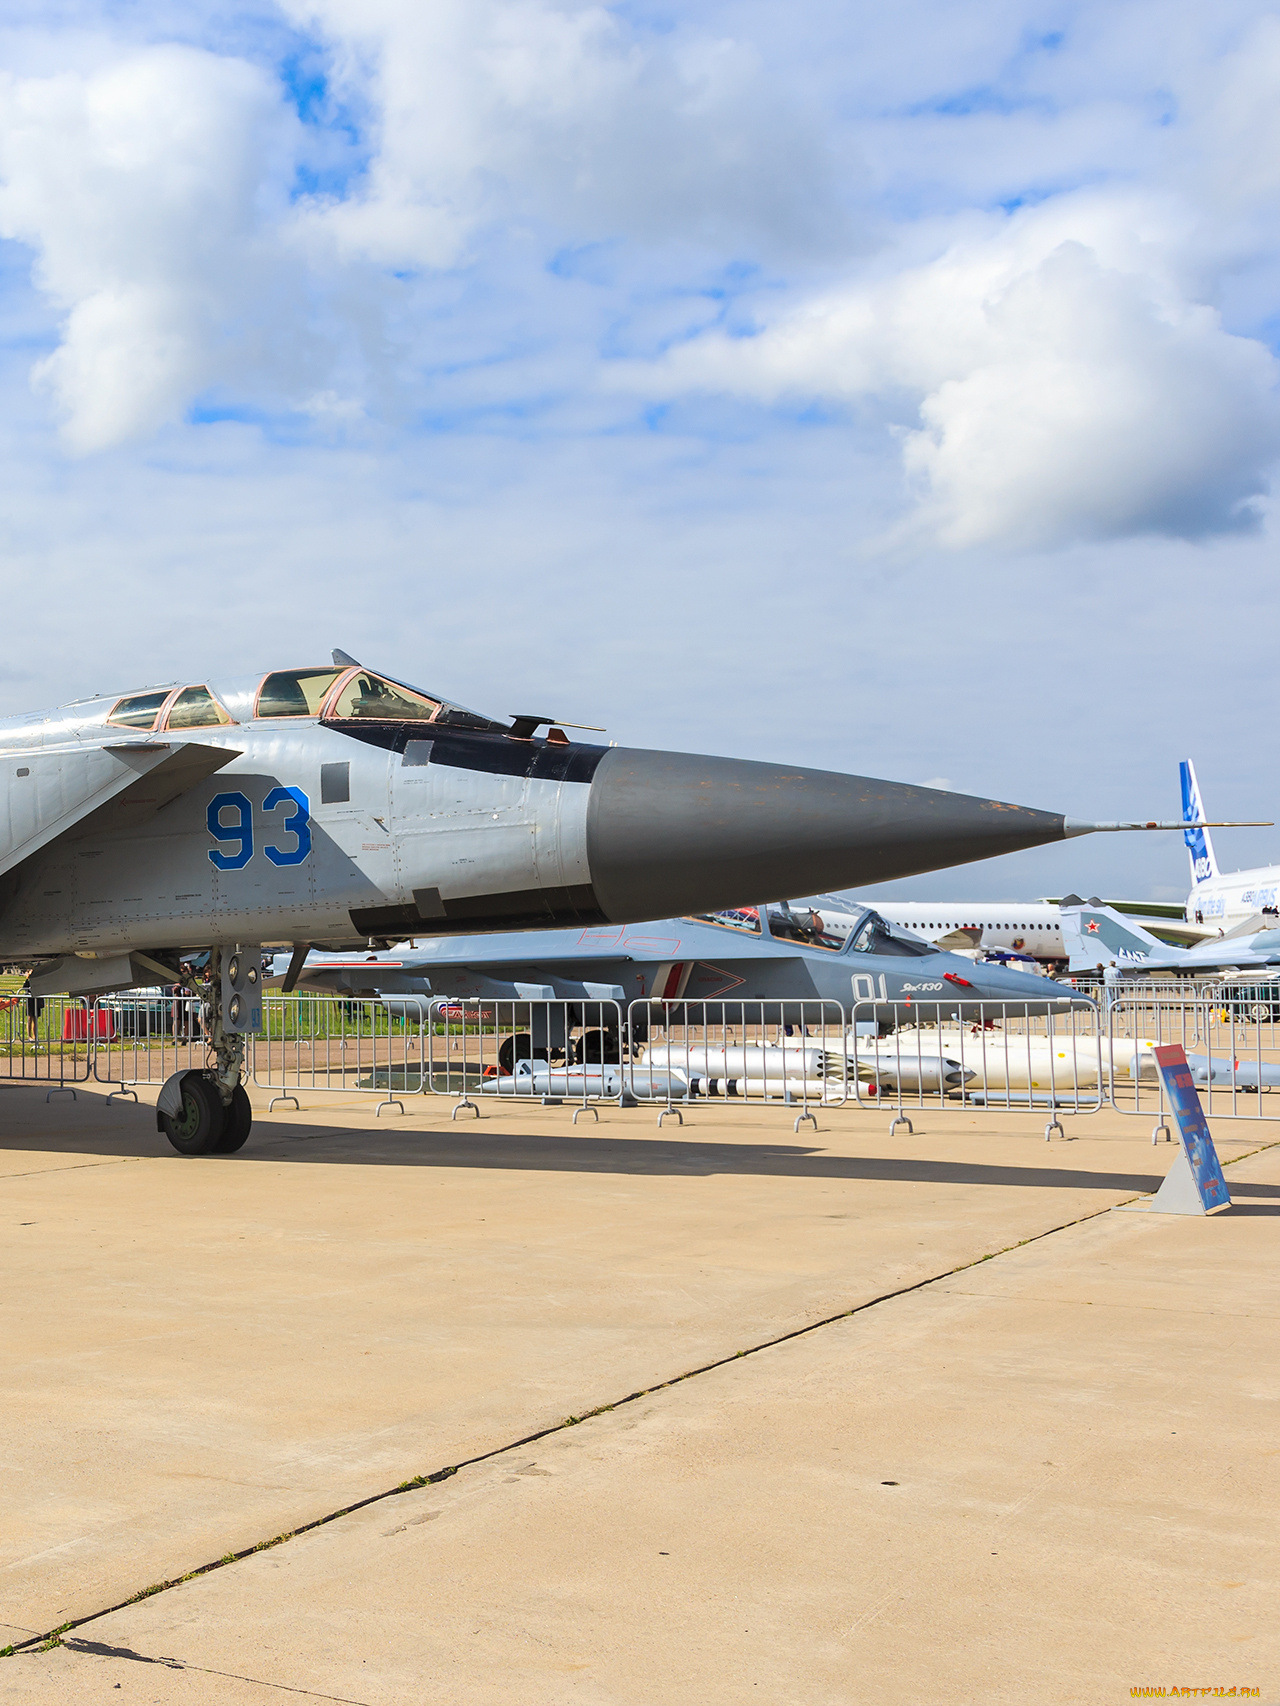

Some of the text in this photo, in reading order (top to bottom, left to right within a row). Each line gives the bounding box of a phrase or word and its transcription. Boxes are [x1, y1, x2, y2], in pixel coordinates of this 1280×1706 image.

[206, 785, 312, 871] 93
[851, 973, 888, 1002] 01
[900, 982, 943, 993] Як-130
